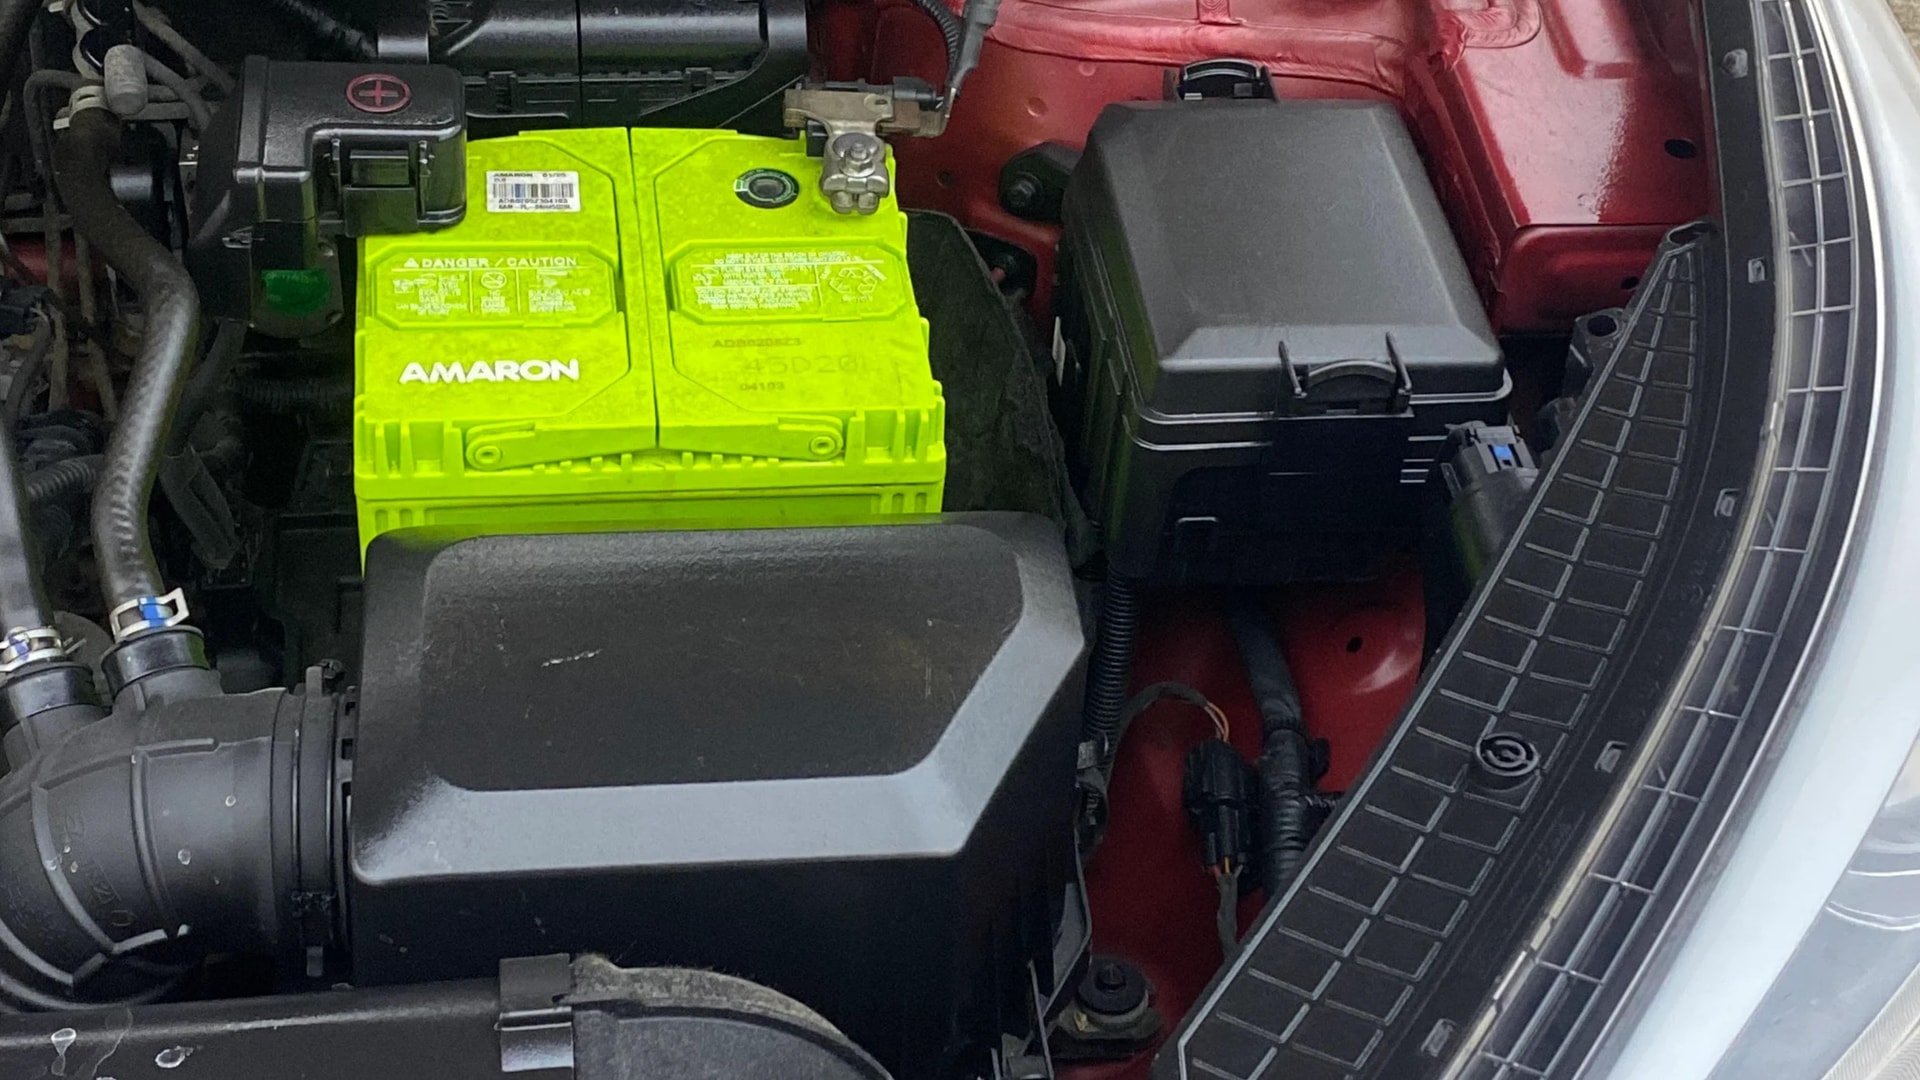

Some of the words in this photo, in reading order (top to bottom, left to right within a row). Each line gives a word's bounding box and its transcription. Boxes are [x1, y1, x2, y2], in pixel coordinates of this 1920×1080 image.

[422, 257, 489, 267] DANGER
[507, 256, 578, 267] CAUTION
[399, 358, 580, 385] AMARON
